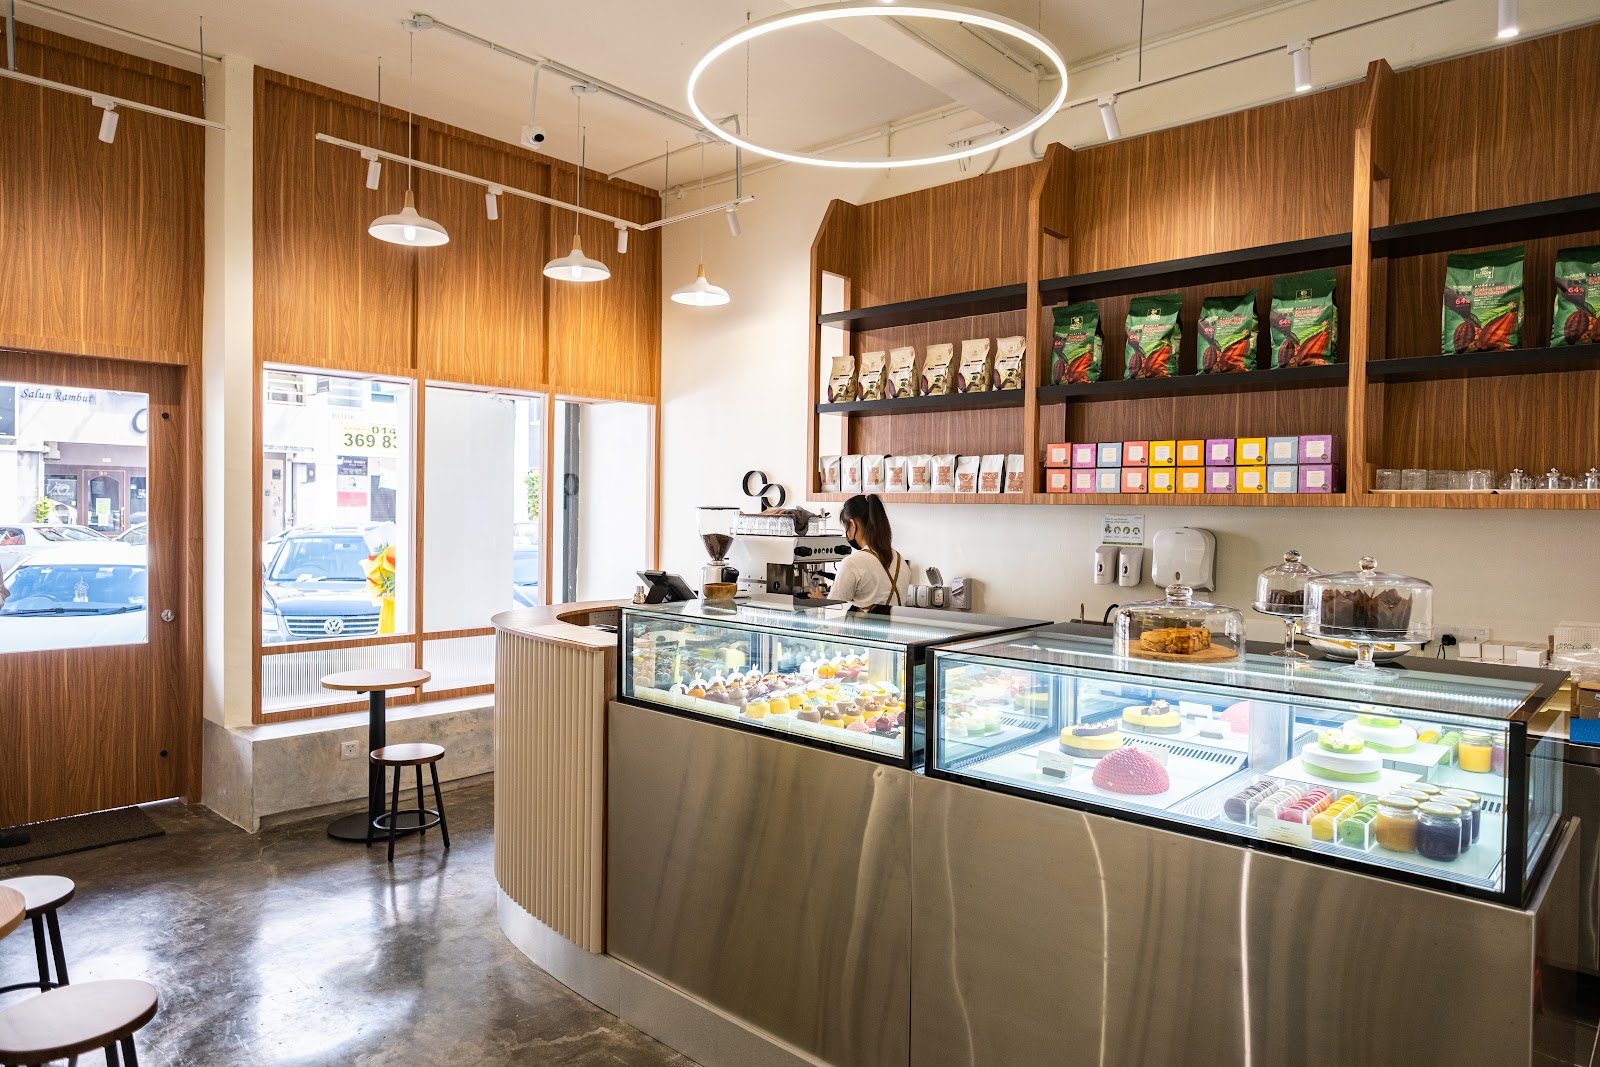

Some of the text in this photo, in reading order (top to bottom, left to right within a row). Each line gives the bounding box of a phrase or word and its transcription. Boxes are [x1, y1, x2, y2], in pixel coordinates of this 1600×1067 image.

[20, 388, 93, 403] Salun Rambut
[344, 433, 375, 448] 369
